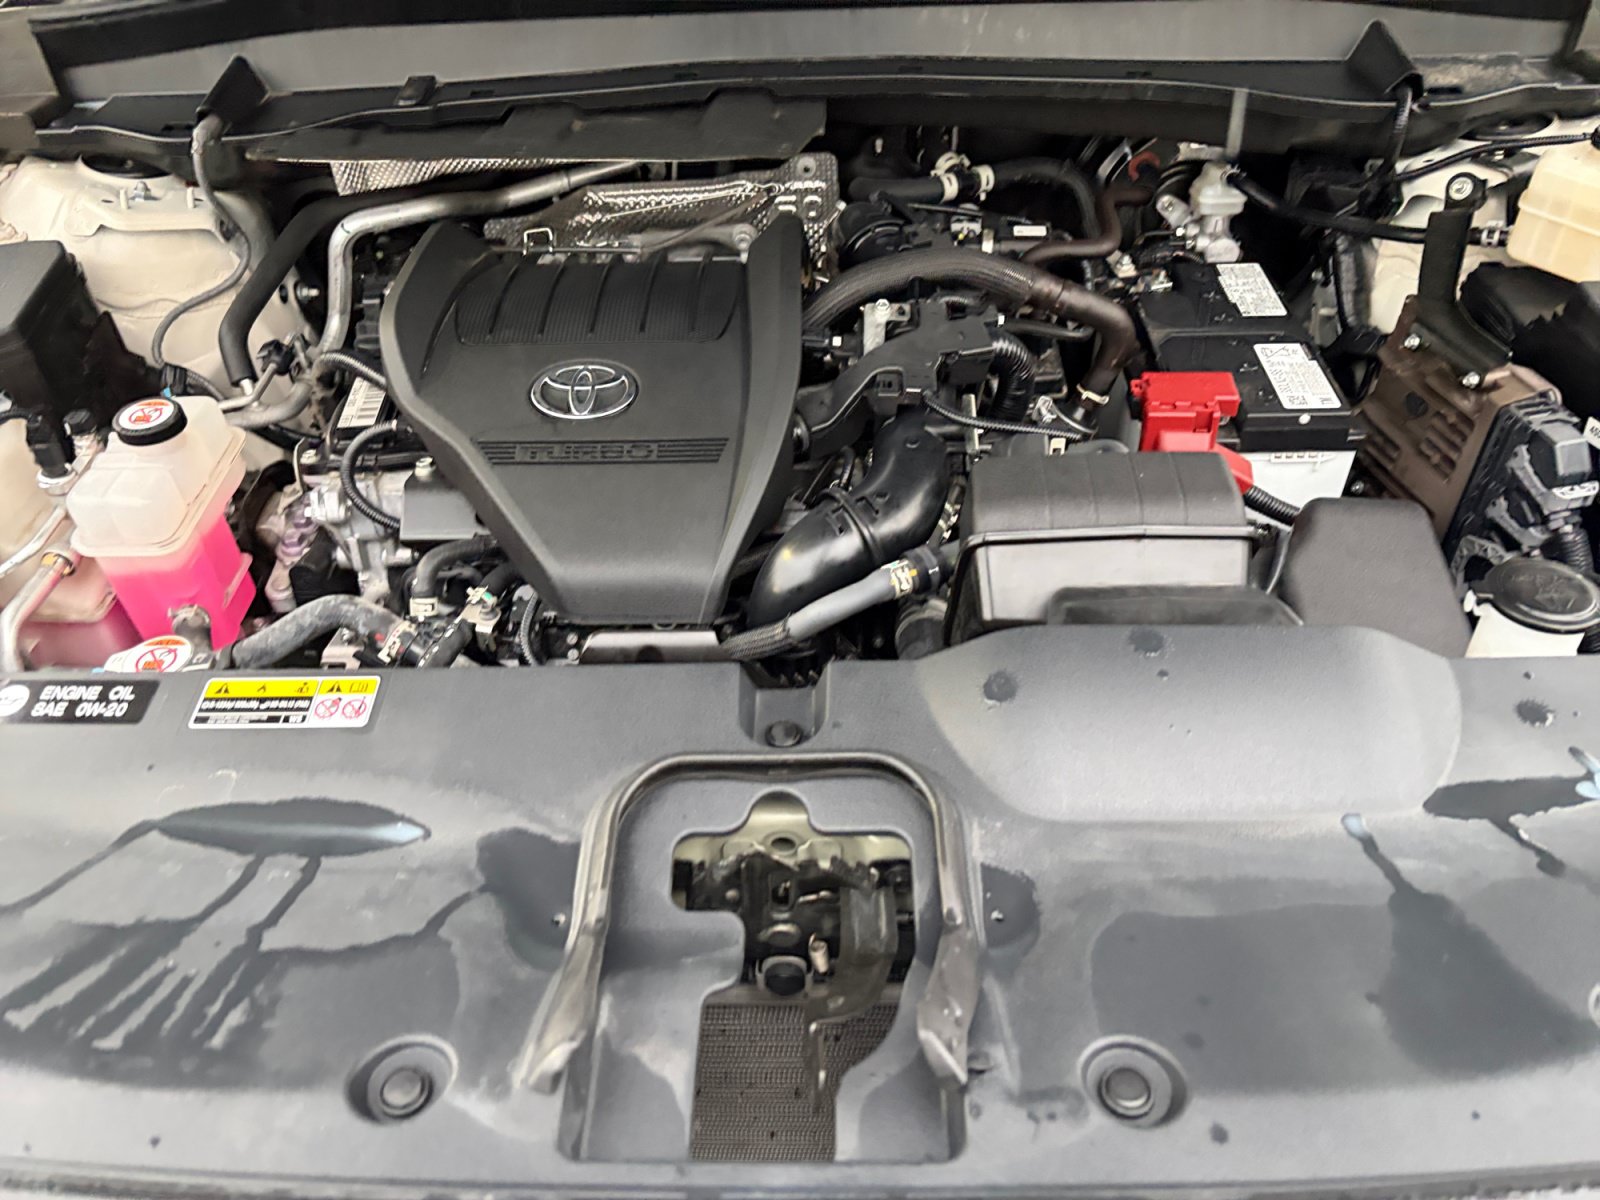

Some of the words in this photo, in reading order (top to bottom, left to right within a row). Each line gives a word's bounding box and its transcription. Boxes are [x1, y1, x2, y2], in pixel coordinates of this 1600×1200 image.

[518, 442, 656, 461] TURBO
[39, 685, 103, 700] ENGINE
[108, 685, 135, 700] OIL
[30, 702, 69, 717] SAE
[75, 702, 129, 717] 0W-20
